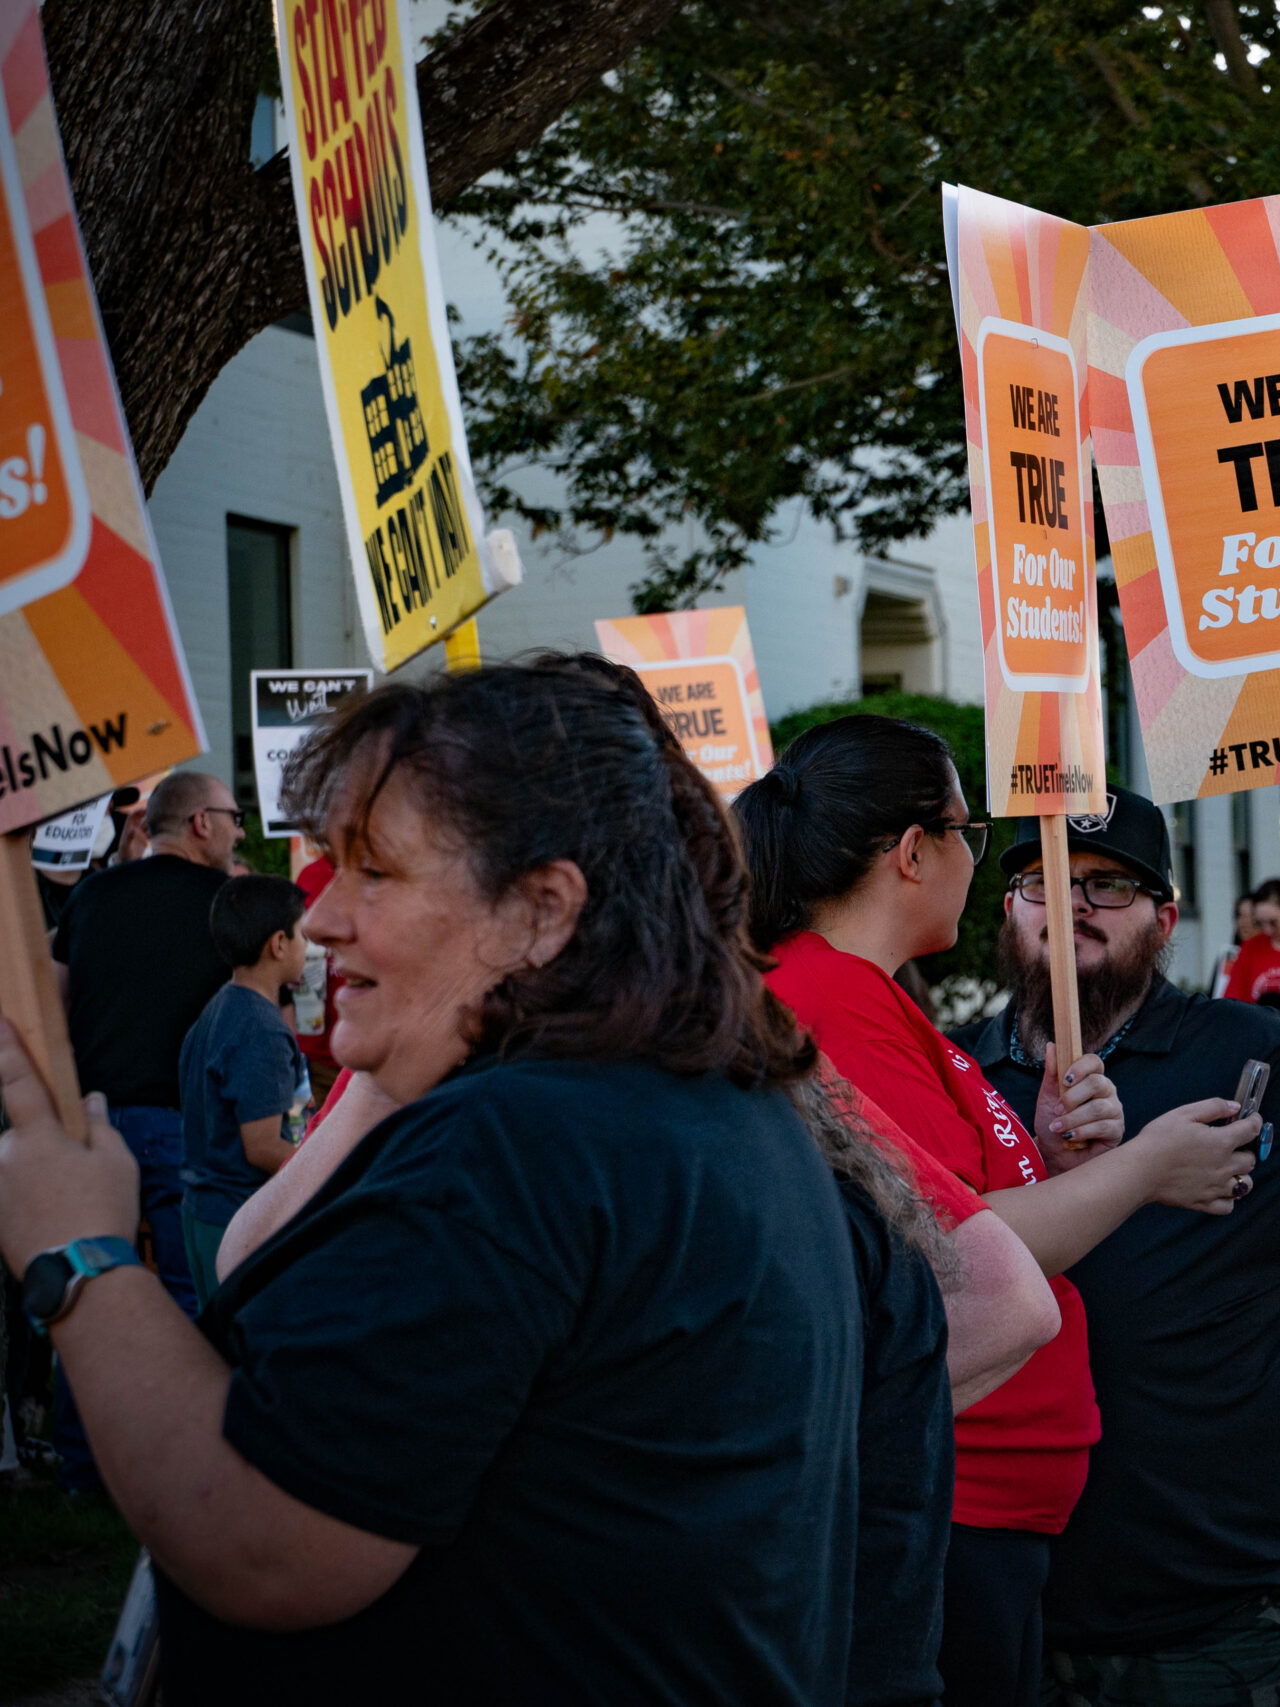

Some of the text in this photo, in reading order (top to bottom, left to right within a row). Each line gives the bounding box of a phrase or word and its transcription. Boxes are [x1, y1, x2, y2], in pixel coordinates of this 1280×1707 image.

[1009, 383, 1061, 438] WE ARE
[1010, 452, 1069, 530] TRUE
[1012, 543, 1076, 593] For Our
[1006, 595, 1084, 644] Students!
[267, 679, 356, 693] WE CAN'T
[658, 682, 715, 704] WE ARE
[702, 745, 737, 763] Our
[1010, 763, 1094, 796] #TRUETimeIsNow
